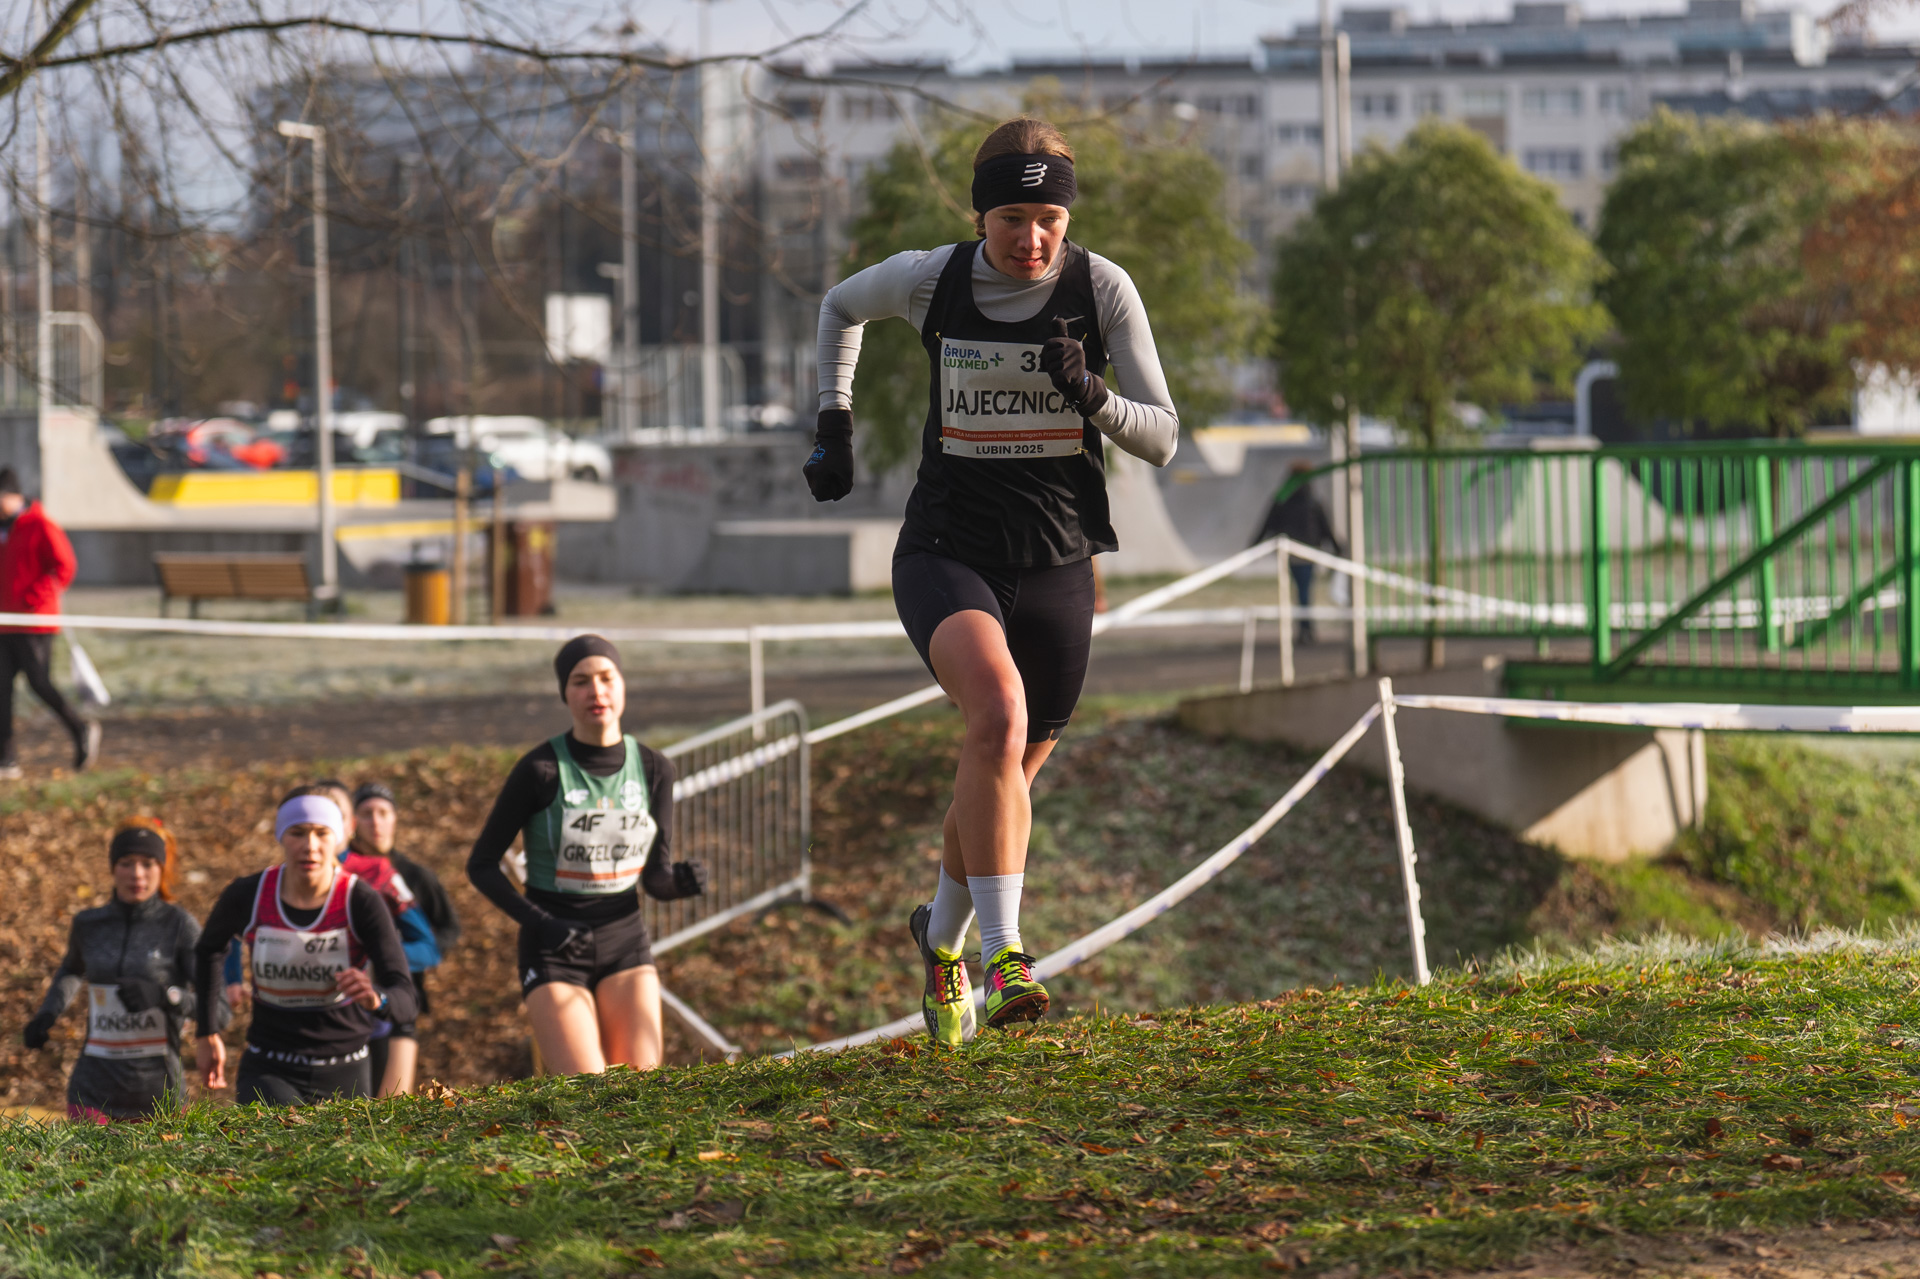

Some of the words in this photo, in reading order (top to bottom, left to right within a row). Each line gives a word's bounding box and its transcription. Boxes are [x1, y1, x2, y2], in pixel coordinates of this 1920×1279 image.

[944, 346, 982, 360] GRUPA
[943, 357, 989, 371] LUXMED
[1020, 431, 1043, 440] Biegach
[976, 445, 1012, 455] LUBIN
[1014, 444, 1044, 454] 2025
[569, 813, 605, 832] 4F
[620, 814, 649, 831] 174
[304, 936, 340, 954] 672
